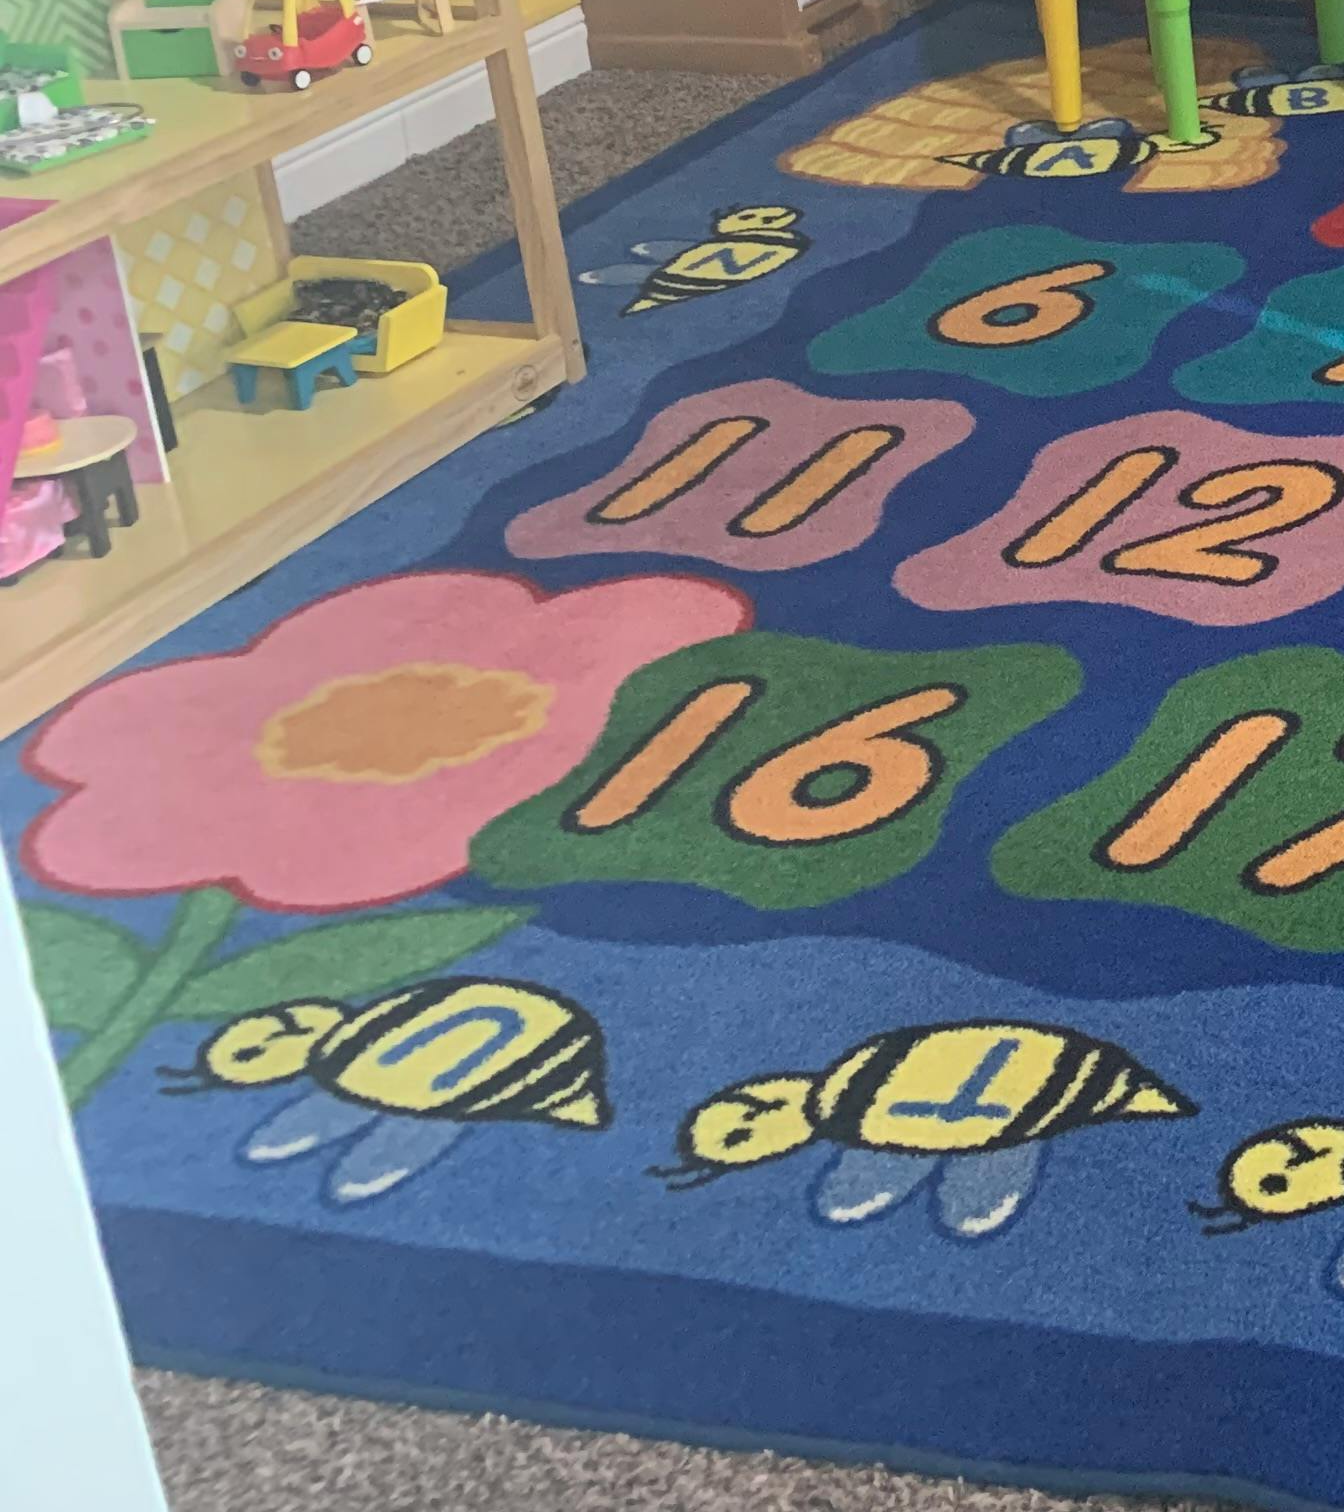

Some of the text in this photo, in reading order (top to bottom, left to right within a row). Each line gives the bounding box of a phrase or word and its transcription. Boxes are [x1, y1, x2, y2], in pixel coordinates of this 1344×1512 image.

[1287, 86, 1330, 110] B
[1034, 145, 1097, 172] A
[926, 259, 1117, 349] 6
[584, 415, 905, 539] 11
[560, 675, 970, 847] 16
[887, 1037, 1023, 1124] T
